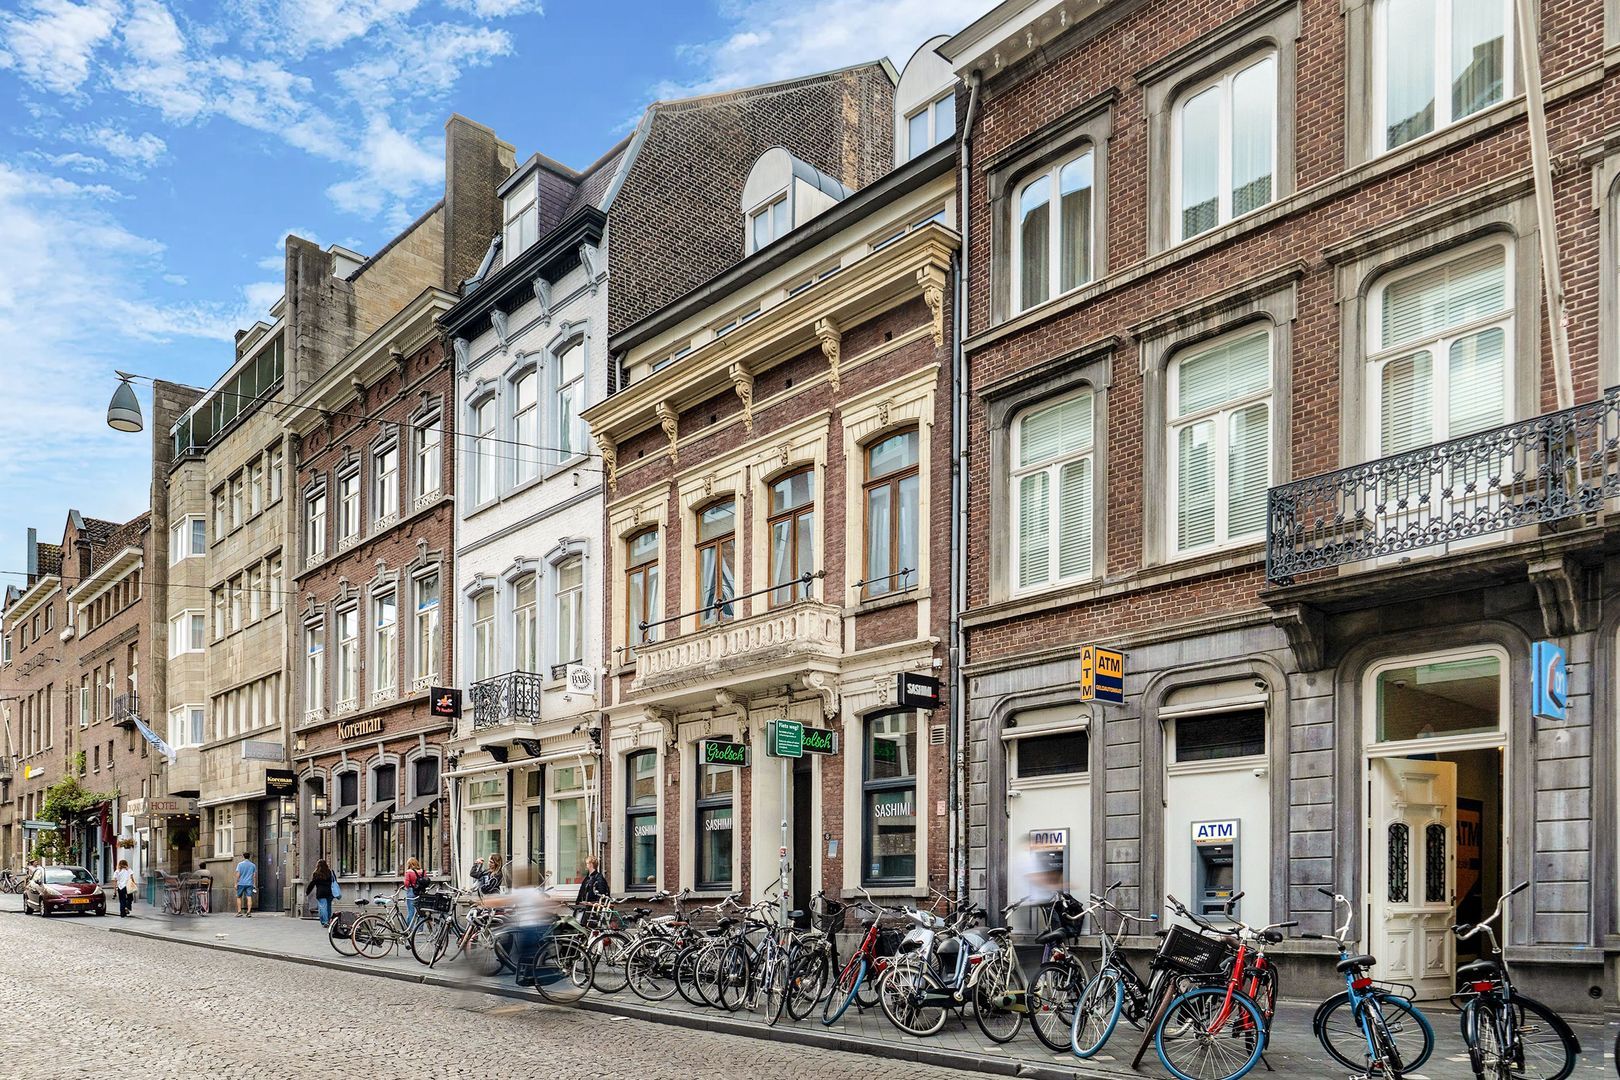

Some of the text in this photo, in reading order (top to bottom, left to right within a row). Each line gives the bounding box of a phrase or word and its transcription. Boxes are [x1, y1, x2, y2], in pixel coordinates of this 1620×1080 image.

[1083, 649, 1092, 696] ATM
[1098, 655, 1121, 673] ATM
[907, 682, 932, 698] SASHIMI
[337, 717, 382, 739] Koreman
[801, 729, 832, 749] rolsch
[706, 743, 744, 761] Grolsch
[151, 801, 180, 811] HOTEL
[875, 802, 911, 818] SASHIMI
[705, 818, 732, 831] SASHIMI
[1197, 823, 1232, 838] ATM
